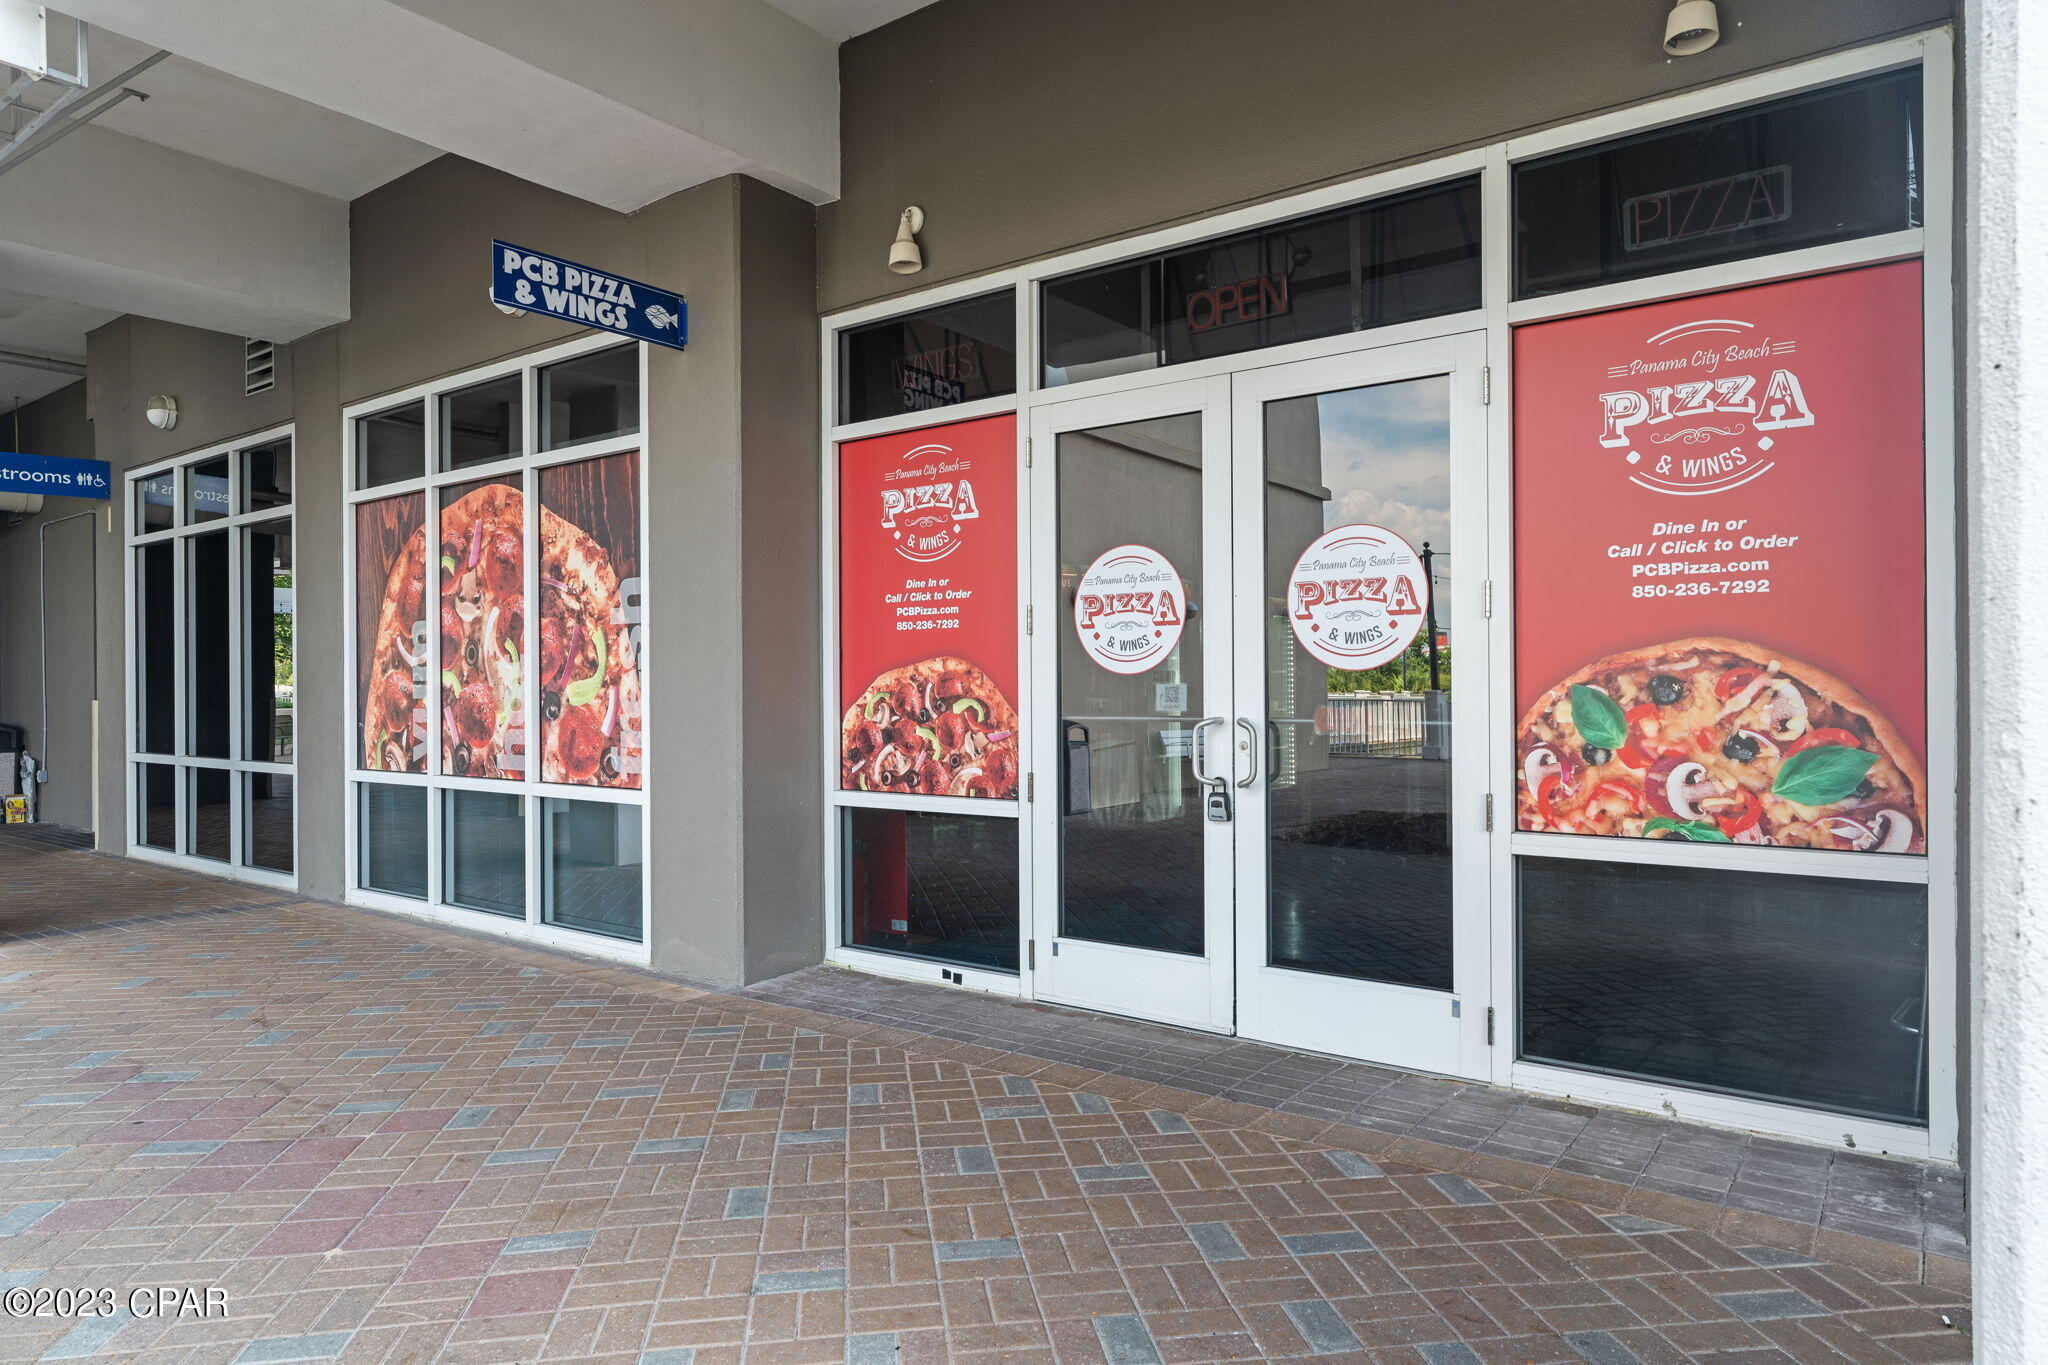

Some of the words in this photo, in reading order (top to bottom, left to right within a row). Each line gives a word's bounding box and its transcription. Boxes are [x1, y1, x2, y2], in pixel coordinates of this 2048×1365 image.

[1635, 173, 1776, 247] PIZZA
[503, 249, 559, 285] PCB
[565, 266, 636, 309] PIZZA
[515, 279, 536, 304] &
[541, 285, 628, 330] WINGS
[1187, 274, 1287, 331] OPEN
[1629, 359, 1687, 376] Panama
[1691, 350, 1720, 372] City
[1725, 337, 1770, 362] Beach
[1599, 369, 1814, 448] PIZZA
[895, 469, 922, 480] Panama
[923, 465, 937, 480] City
[938, 457, 959, 473] Beach
[1655, 455, 1672, 475] &
[1682, 447, 1747, 478] WINGS
[0, 468, 71, 485] trooms
[881, 480, 979, 528] PIZZA
[1652, 521, 1695, 536] Dine
[1701, 519, 1719, 532] In
[1725, 519, 1747, 531] or
[907, 534, 915, 548] &
[919, 530, 949, 550] WINGS
[1607, 543, 1642, 558] Call
[1646, 543, 1657, 556] /
[1661, 540, 1708, 555] Click
[1714, 538, 1733, 552] to
[1740, 534, 1799, 550] Order
[1312, 559, 1347, 571] Panama
[1350, 557, 1366, 573] City
[1369, 552, 1396, 567] Beach
[1632, 559, 1769, 577] PCBPizza.com
[906, 579, 925, 588] Dine
[928, 578, 936, 587] In
[939, 578, 949, 586] or
[1095, 575, 1122, 585] Panama
[1124, 573, 1137, 588] City
[1139, 570, 1160, 583] Beach
[1631, 579, 1770, 598] 850-236-7292
[885, 593, 902, 603] Call
[903, 593, 908, 602] /
[910, 592, 932, 602] Click
[934, 591, 943, 600] to
[946, 590, 972, 599] Order
[1295, 575, 1421, 620] PIZZA
[896, 606, 959, 616] PCBPizza.com
[1080, 590, 1180, 629] PIZZA
[896, 619, 959, 630] 850-236-7292
[1328, 628, 1339, 642] &
[1344, 625, 1383, 645] WINGS
[1107, 636, 1115, 648] &
[1119, 635, 1150, 651] WINGS
